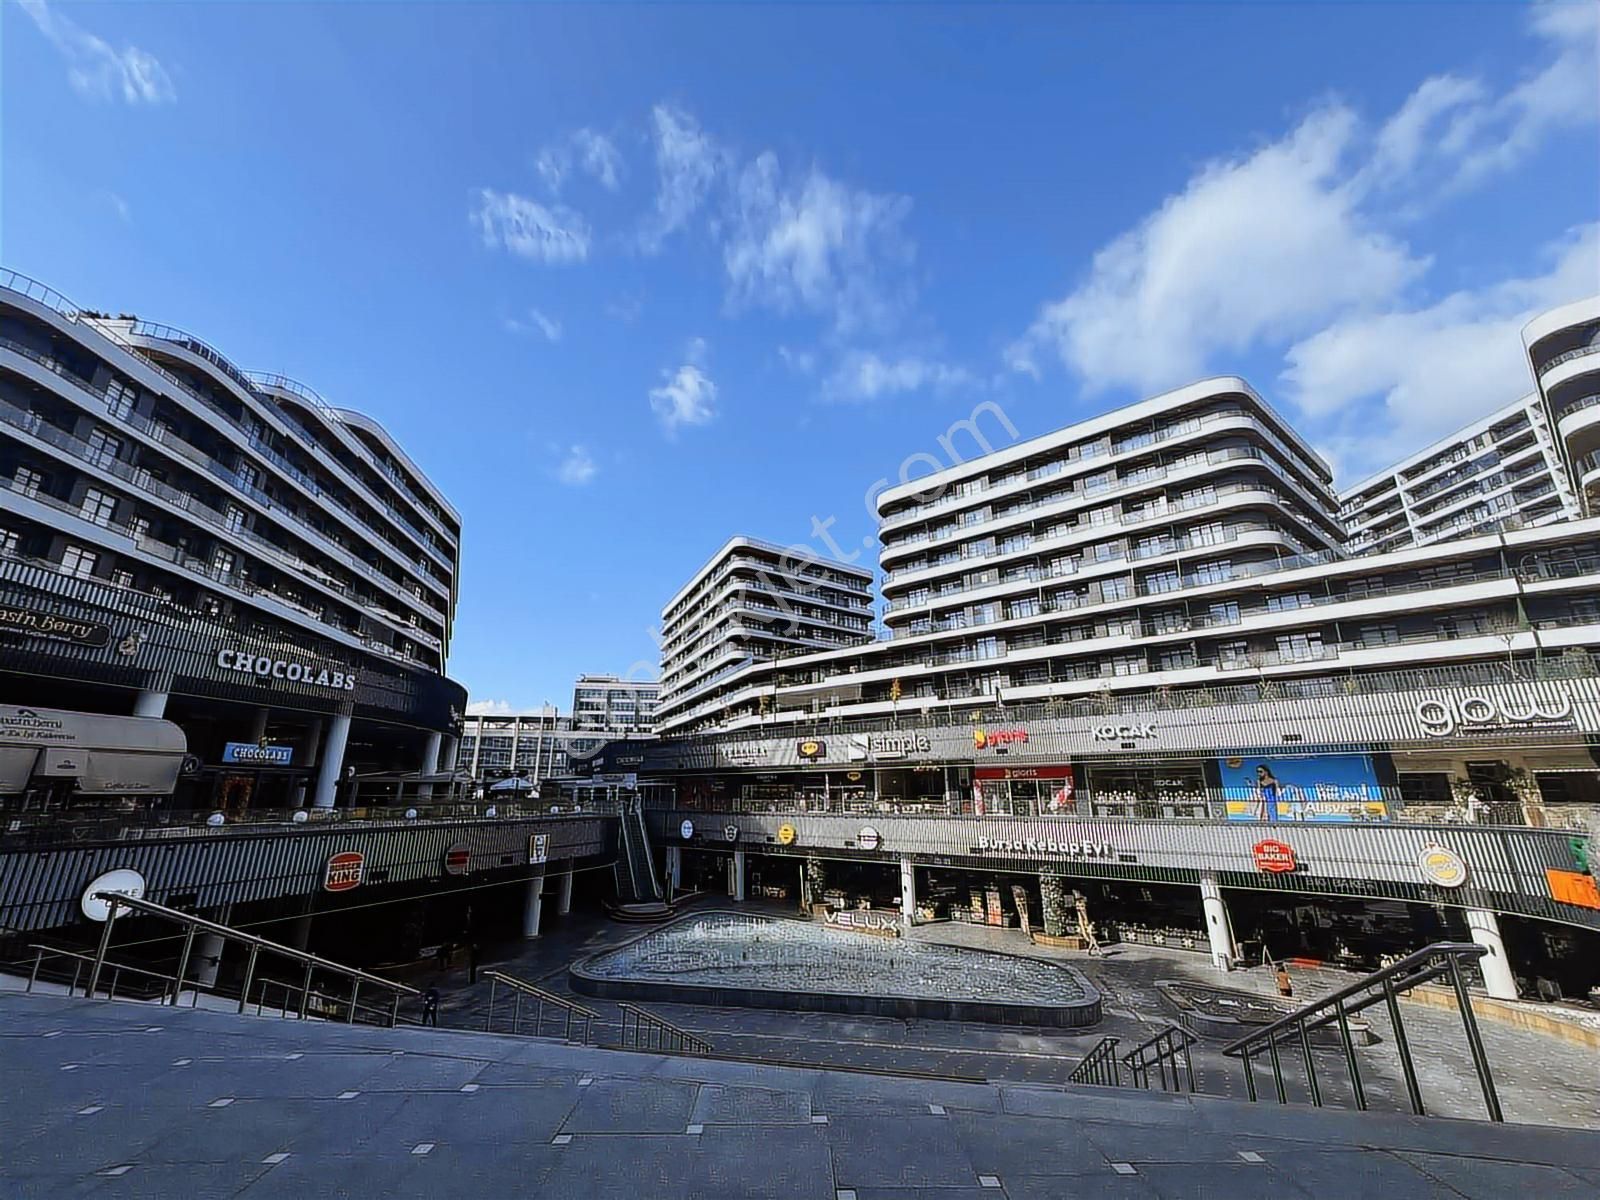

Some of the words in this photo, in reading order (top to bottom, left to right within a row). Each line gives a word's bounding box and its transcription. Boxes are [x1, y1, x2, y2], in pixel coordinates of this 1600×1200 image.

[40, 615, 92, 638] Berry
[217, 649, 356, 690] CHOCOLABS
[1416, 686, 1574, 737] glow
[233, 747, 288, 760] CHOCOLABS
[873, 731, 929, 757] simple
[979, 835, 1023, 850] Bursa
[1025, 838, 1080, 857] Kebap
[1258, 853, 1289, 861] BAKER
[1263, 845, 1280, 853] BIG
[328, 870, 360, 885] KING
[823, 909, 898, 932] VELUX
